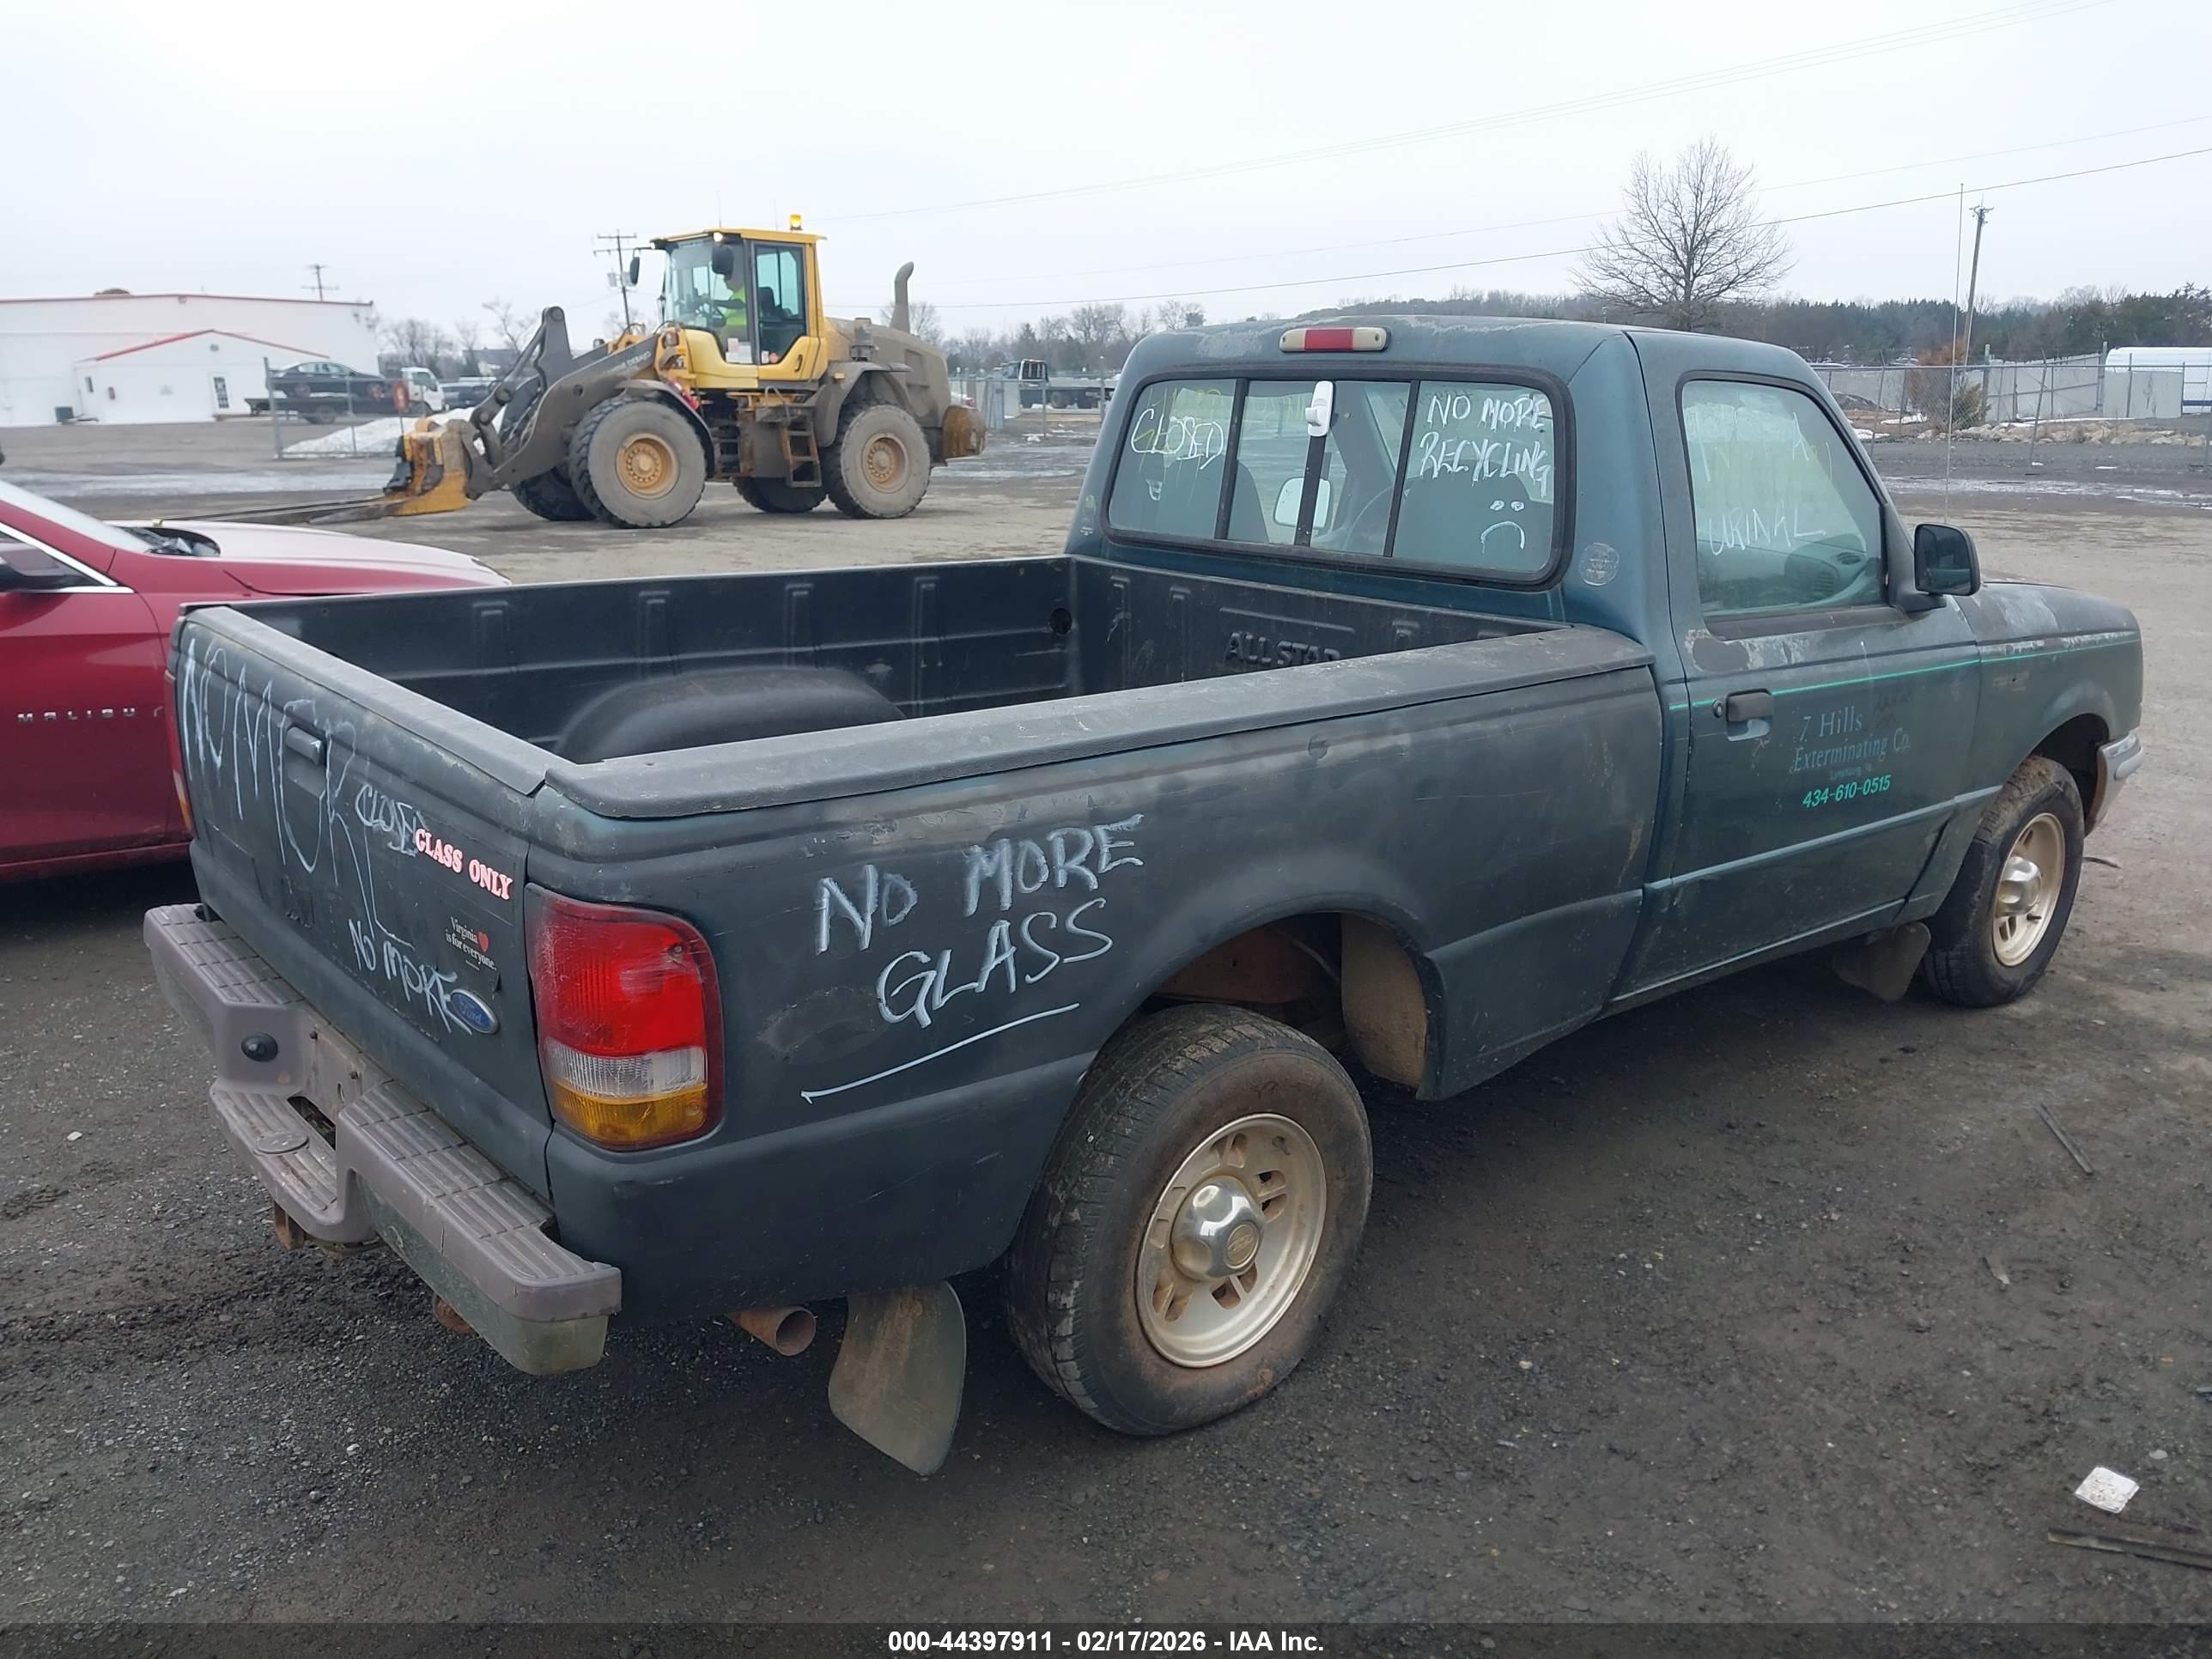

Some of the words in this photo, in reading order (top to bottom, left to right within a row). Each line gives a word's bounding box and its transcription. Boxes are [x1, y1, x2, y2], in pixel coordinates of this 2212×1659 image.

[1426, 394, 1472, 428] NO
[1477, 393, 1547, 432] MORE
[1131, 409, 1224, 470] CLOSED
[1419, 431, 1553, 497] RECYCLING
[1708, 498, 1827, 556] URINAL
[17, 707, 136, 723] MALIBU
[1799, 715, 1812, 743] 7
[1819, 706, 1863, 737] Hills
[1794, 732, 1889, 772] Exterminating
[1802, 775, 1892, 808] 434-610-0515
[468, 859, 514, 900] ONLY
[812, 864, 918, 955] NO
[962, 814, 1145, 917] MORE
[349, 919, 376, 971] NO
[445, 928, 452, 943] is
[452, 932, 463, 951] for
[463, 944, 497, 971] everyone.
[451, 916, 478, 945] Virginia
[876, 897, 1113, 1029] GLASS
